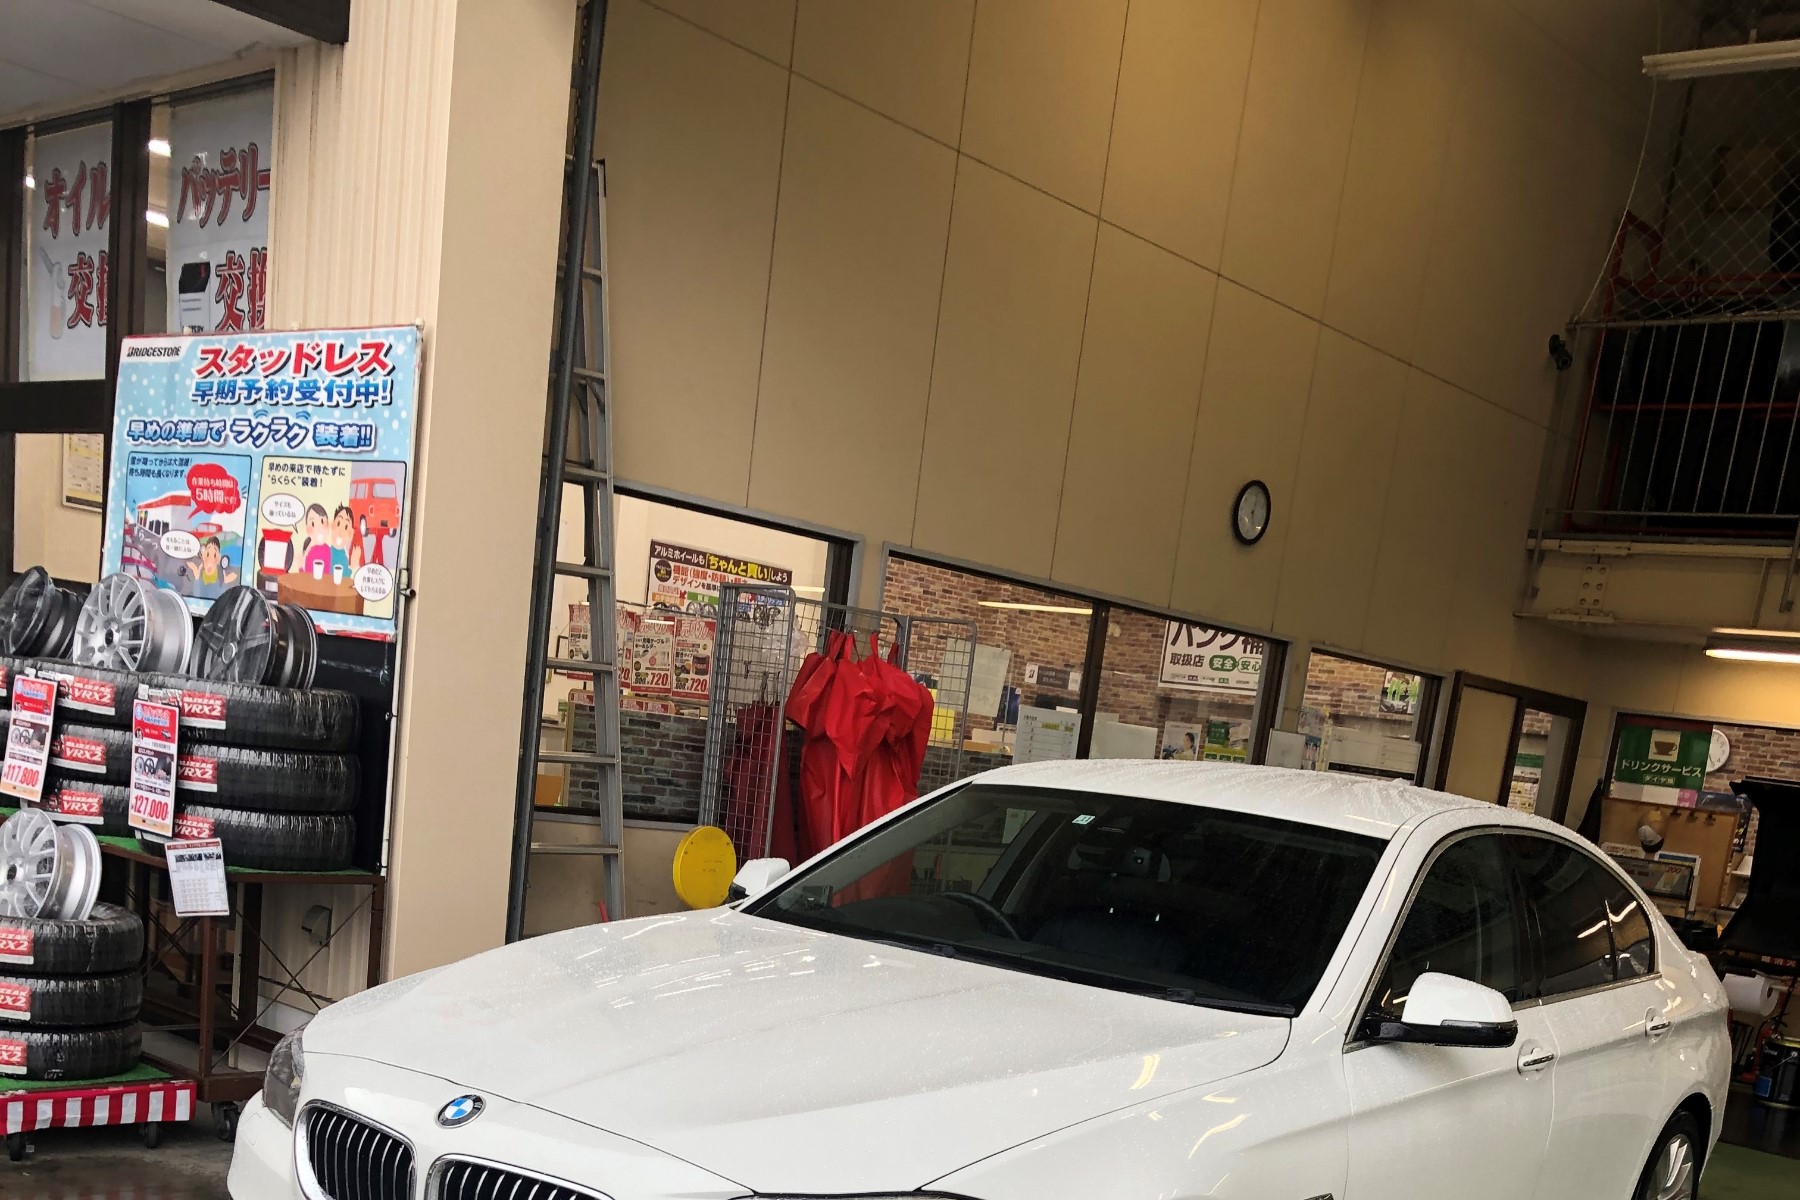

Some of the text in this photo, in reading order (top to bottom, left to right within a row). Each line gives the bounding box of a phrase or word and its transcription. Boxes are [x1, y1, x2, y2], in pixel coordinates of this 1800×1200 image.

[43, 160, 110, 239] オイル
[67, 250, 108, 328] 交
[126, 345, 182, 357] BRIDGESTONE
[195, 341, 393, 377] スタッドレス
[191, 377, 392, 406] 早期予約受付中!
[127, 419, 225, 442] 早めの準備で
[230, 416, 308, 448] ラクラク
[268, 462, 346, 476] 早めの来店で待たずに
[1169, 652, 1205, 668] 取扱店
[1212, 658, 1234, 670] 安全
[73, 687, 111, 703] VRX2
[184, 703, 221, 717] VRX2
[65, 747, 102, 761] VRX2
[178, 767, 213, 779] VRX2
[1621, 759, 1702, 778] ドリンクサービス
[61, 801, 99, 813] VRX2
[174, 825, 210, 838] VRX2
[0, 939, 28, 950] RX2
[0, 994, 26, 1006] RX2
[0, 1051, 21, 1061] X2
